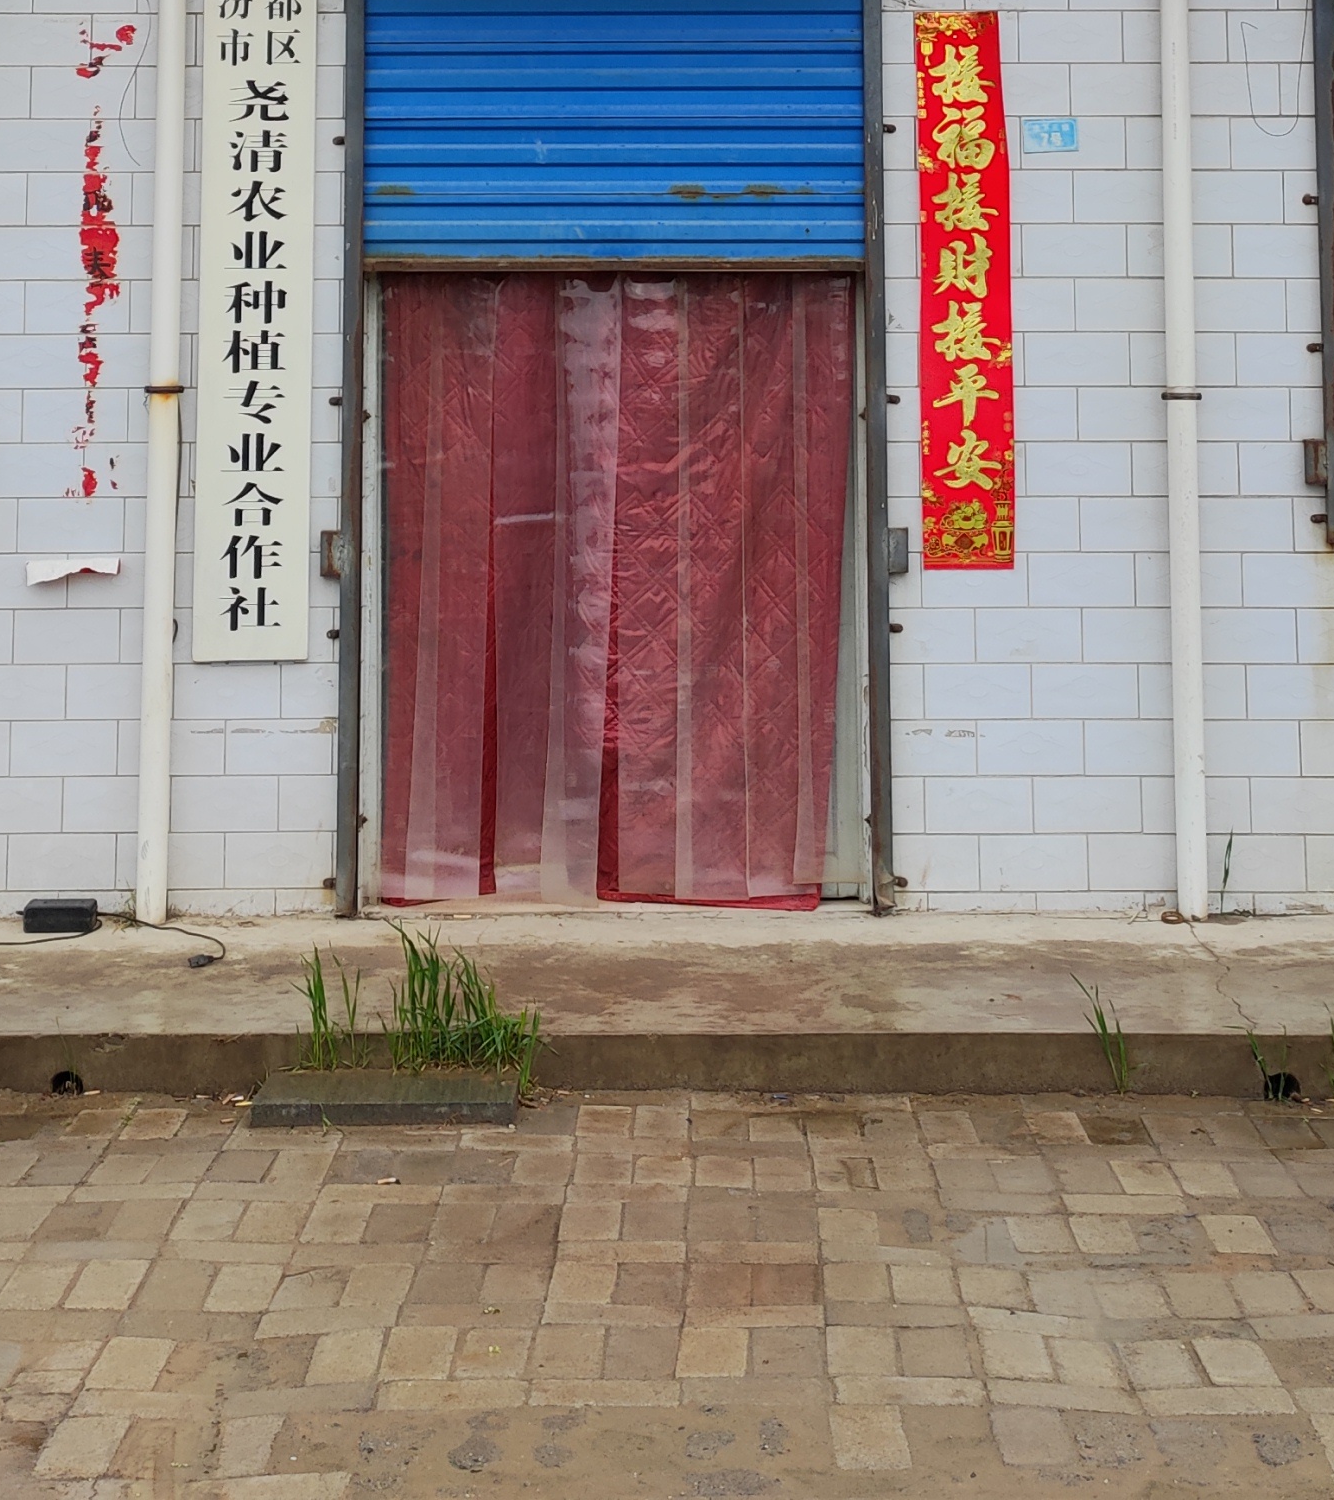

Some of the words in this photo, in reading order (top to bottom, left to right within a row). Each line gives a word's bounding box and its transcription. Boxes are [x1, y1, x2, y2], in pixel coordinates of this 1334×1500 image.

[219, 79, 289, 632] 尧清农业种植专业合作社
